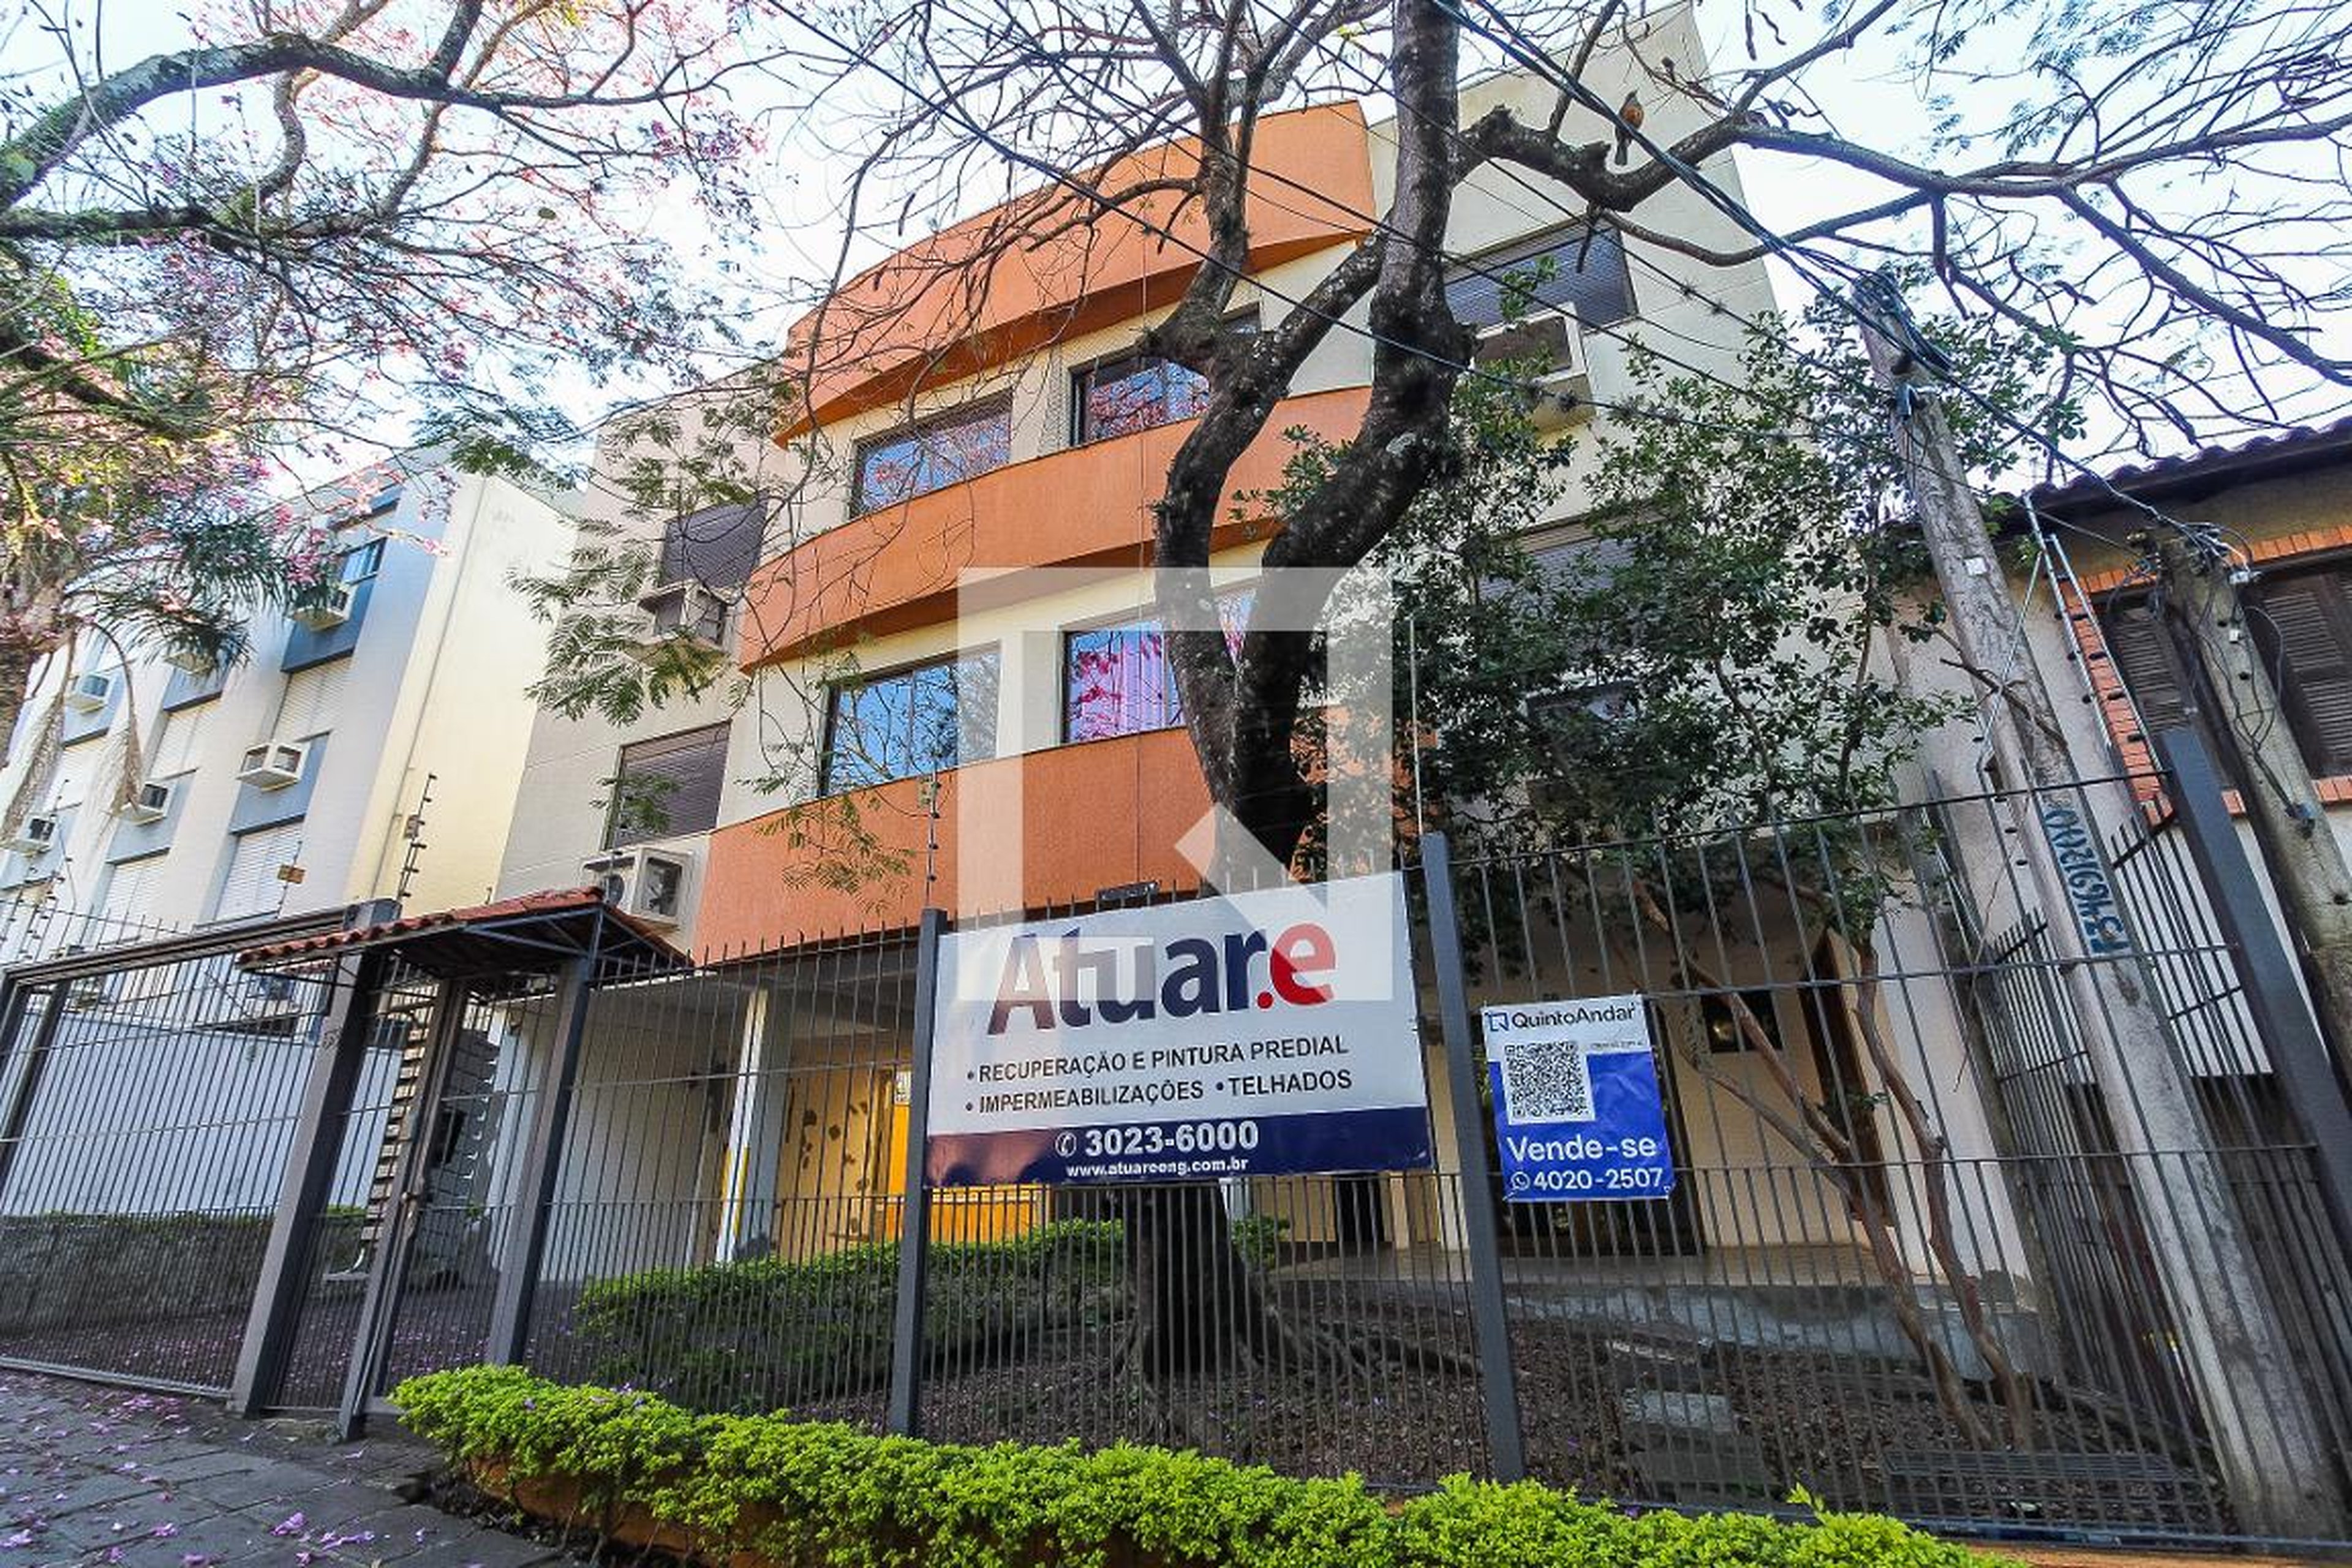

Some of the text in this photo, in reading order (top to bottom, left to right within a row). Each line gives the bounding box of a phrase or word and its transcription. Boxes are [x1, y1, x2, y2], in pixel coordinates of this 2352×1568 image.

[987, 922, 1337, 1035] Atuar.e
[1511, 1003, 1635, 1028] QuintoAndar
[979, 1035, 1349, 1082] RECUPERAÇÃO E PINTURA PREDIAL
[979, 1069, 1352, 1114] IMPERMEABILIZAÇÕES TELHADOS
[1085, 1120, 1259, 1157] 3023-6000
[1506, 1133, 1657, 1162] Vende-se
[1532, 1167, 1664, 1190] 4020-2507
